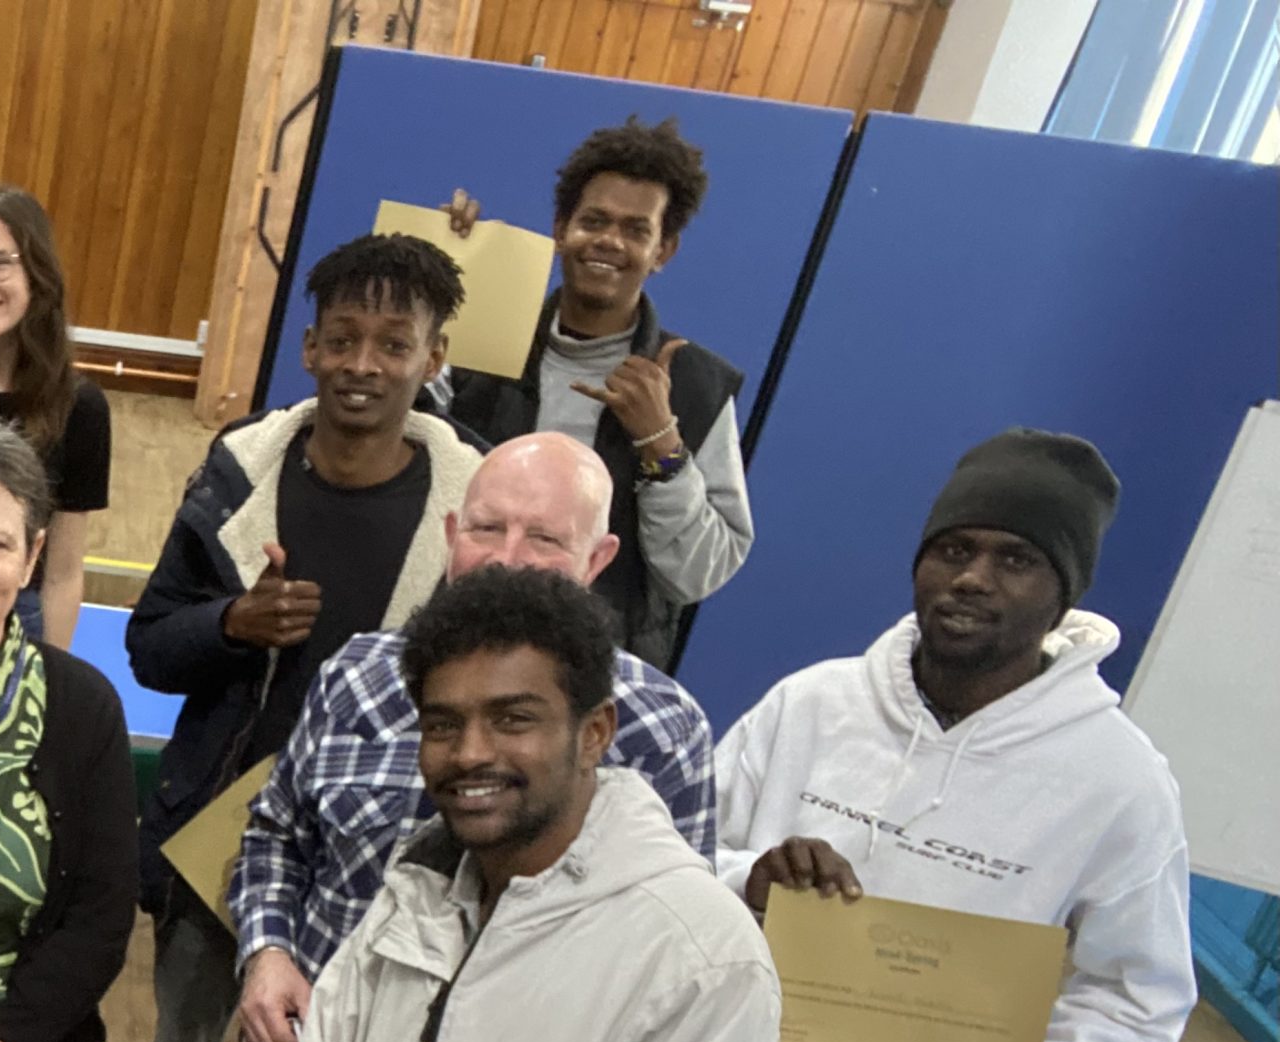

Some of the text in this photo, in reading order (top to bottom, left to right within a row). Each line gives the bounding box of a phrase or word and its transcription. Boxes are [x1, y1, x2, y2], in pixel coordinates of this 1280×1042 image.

[895, 841, 1005, 881] SURF CLUB
[923, 838, 1034, 875] COAST
